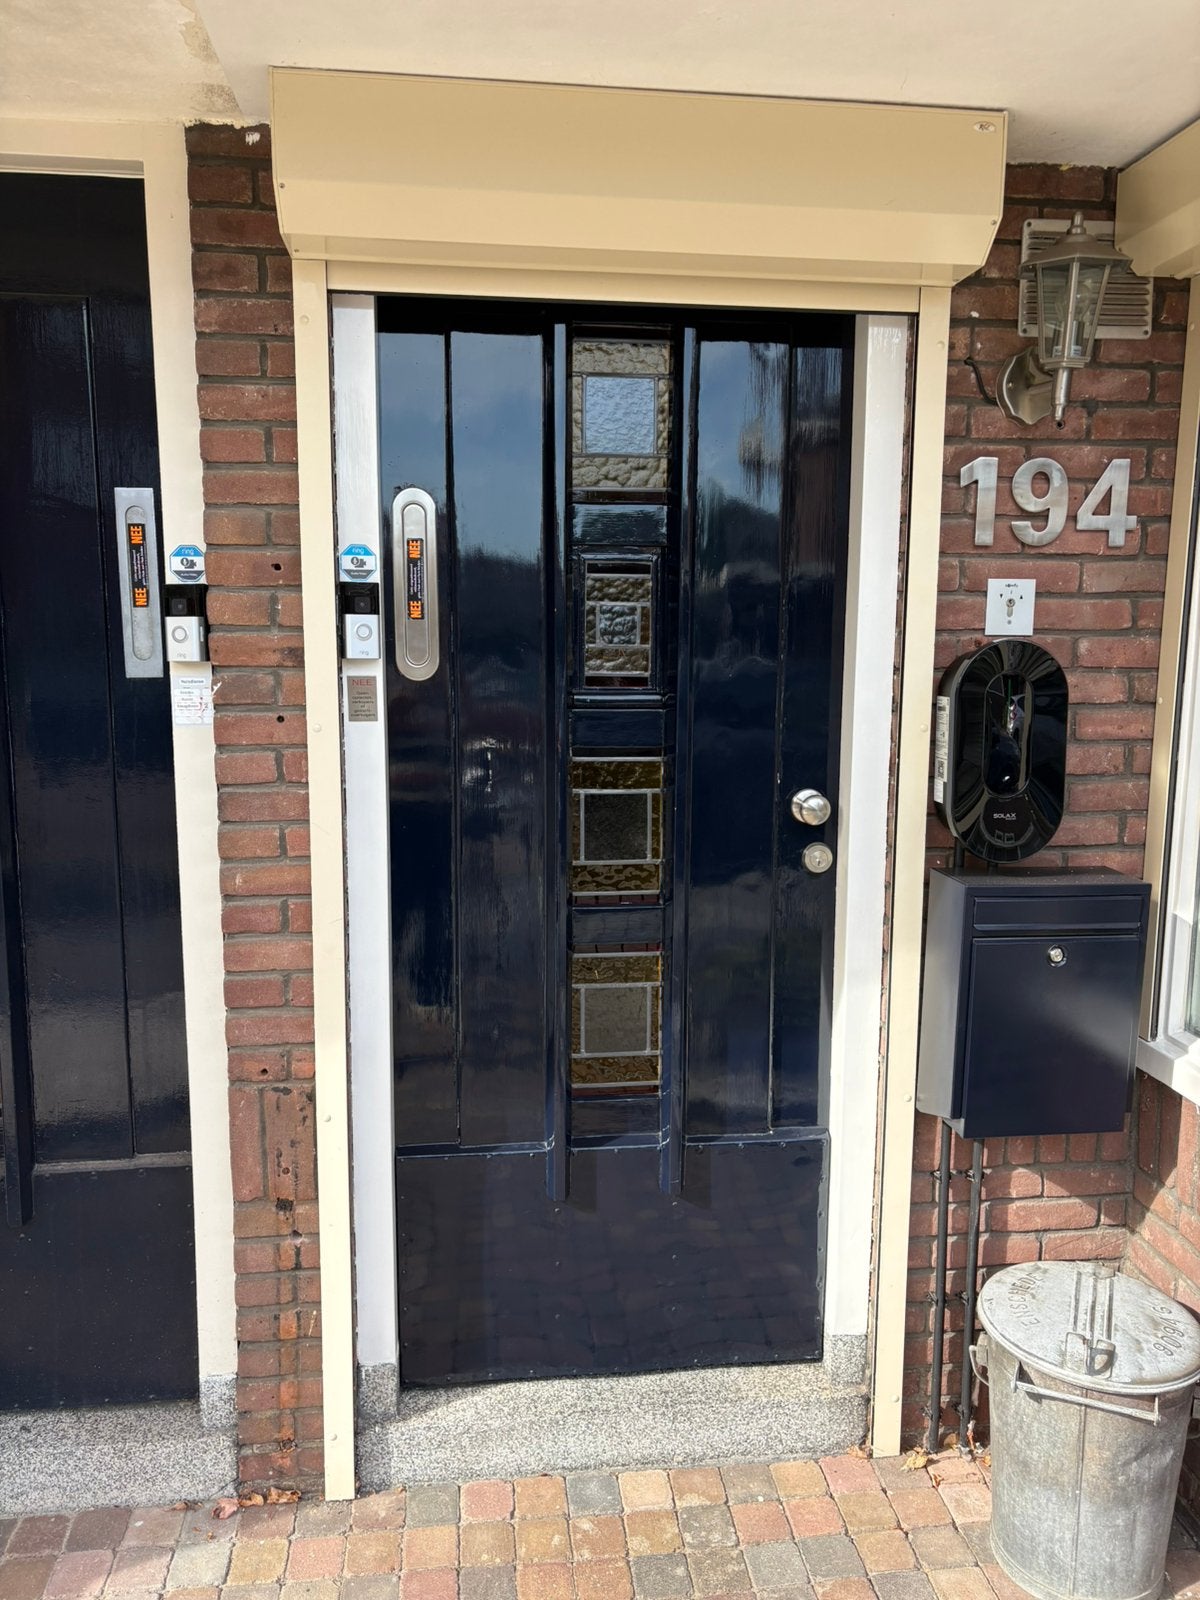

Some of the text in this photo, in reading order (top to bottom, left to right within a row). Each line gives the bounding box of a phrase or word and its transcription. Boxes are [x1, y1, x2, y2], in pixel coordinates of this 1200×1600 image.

[960, 456, 1137, 547] 194
[130, 526, 143, 544] NEE
[409, 541, 421, 558] NEE
[134, 588, 148, 606] NEE
[410, 601, 422, 618] NEE
[352, 678, 373, 686] NEE
[1008, 1272, 1044, 1327] ENSCHEDE
